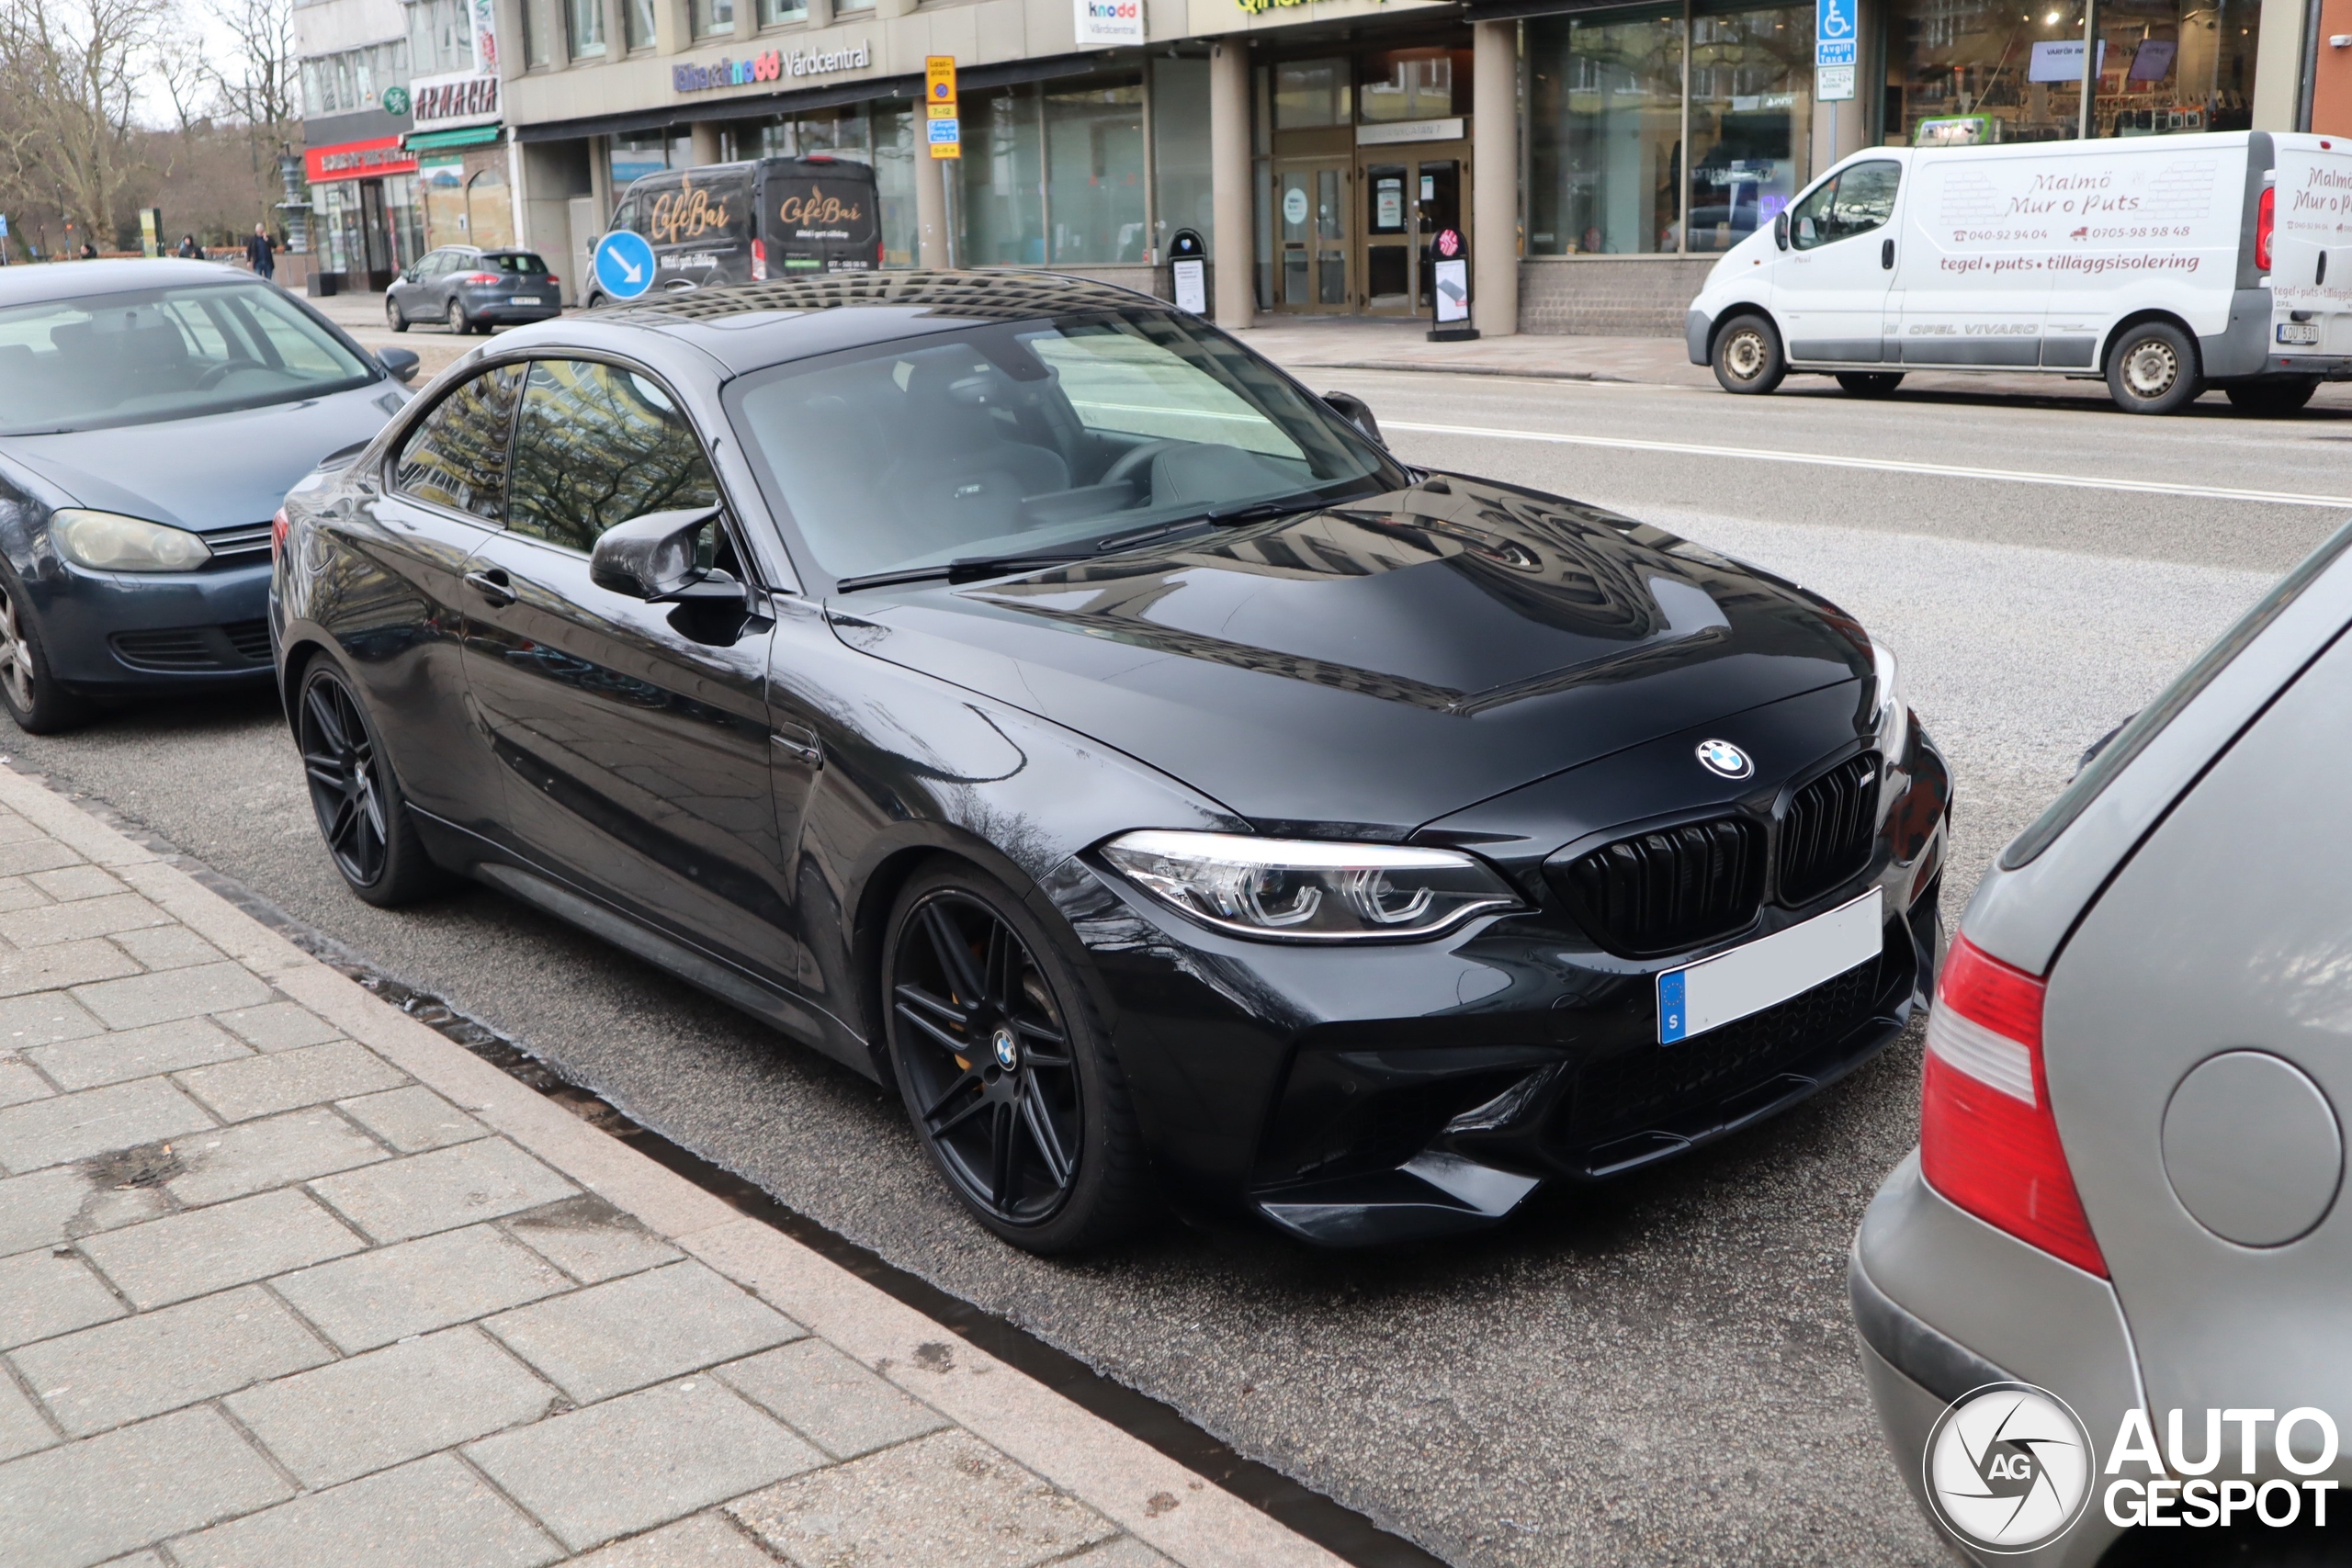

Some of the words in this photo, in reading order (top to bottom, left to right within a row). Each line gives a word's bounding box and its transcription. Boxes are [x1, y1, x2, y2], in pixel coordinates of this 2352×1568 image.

[1089, 1, 1136, 18] knodd
[1089, 23, 1136, 35] Vårdcentral
[1823, 43, 1850, 54] Avgift
[2047, 47, 2073, 55] VARFÖR
[783, 38, 871, 77] Vårdcentral
[1820, 55, 1842, 63] Taxa
[1846, 53, 1852, 62] A
[933, 107, 951, 116] 7-12
[2029, 170, 2112, 195] Malmö
[2005, 197, 2057, 218] Mur
[2063, 199, 2075, 212] o
[2081, 194, 2140, 215] Puts
[2293, 189, 2326, 211] Mur
[2330, 197, 2337, 211] o
[2340, 194, 2352, 216] P
[1969, 230, 2011, 241] 040-92
[2013, 230, 2029, 241] 94
[2031, 229, 2048, 240] 04
[2092, 226, 2147, 238] 0705-98
[2150, 226, 2169, 237] 98
[2173, 225, 2190, 237] 48
[1940, 256, 1983, 275] tegel
[1994, 257, 2033, 274] puts
[2047, 254, 2199, 274] tilläggsisolering
[2274, 285, 2296, 299] tegel
[2301, 287, 2318, 299] puts
[2324, 287, 2352, 302] tilläggsi
[1908, 324, 1957, 335] OPEL
[1964, 323, 2039, 335] VIVARO
[2302, 327, 2316, 340] 531
[1668, 1014, 1679, 1029] S
